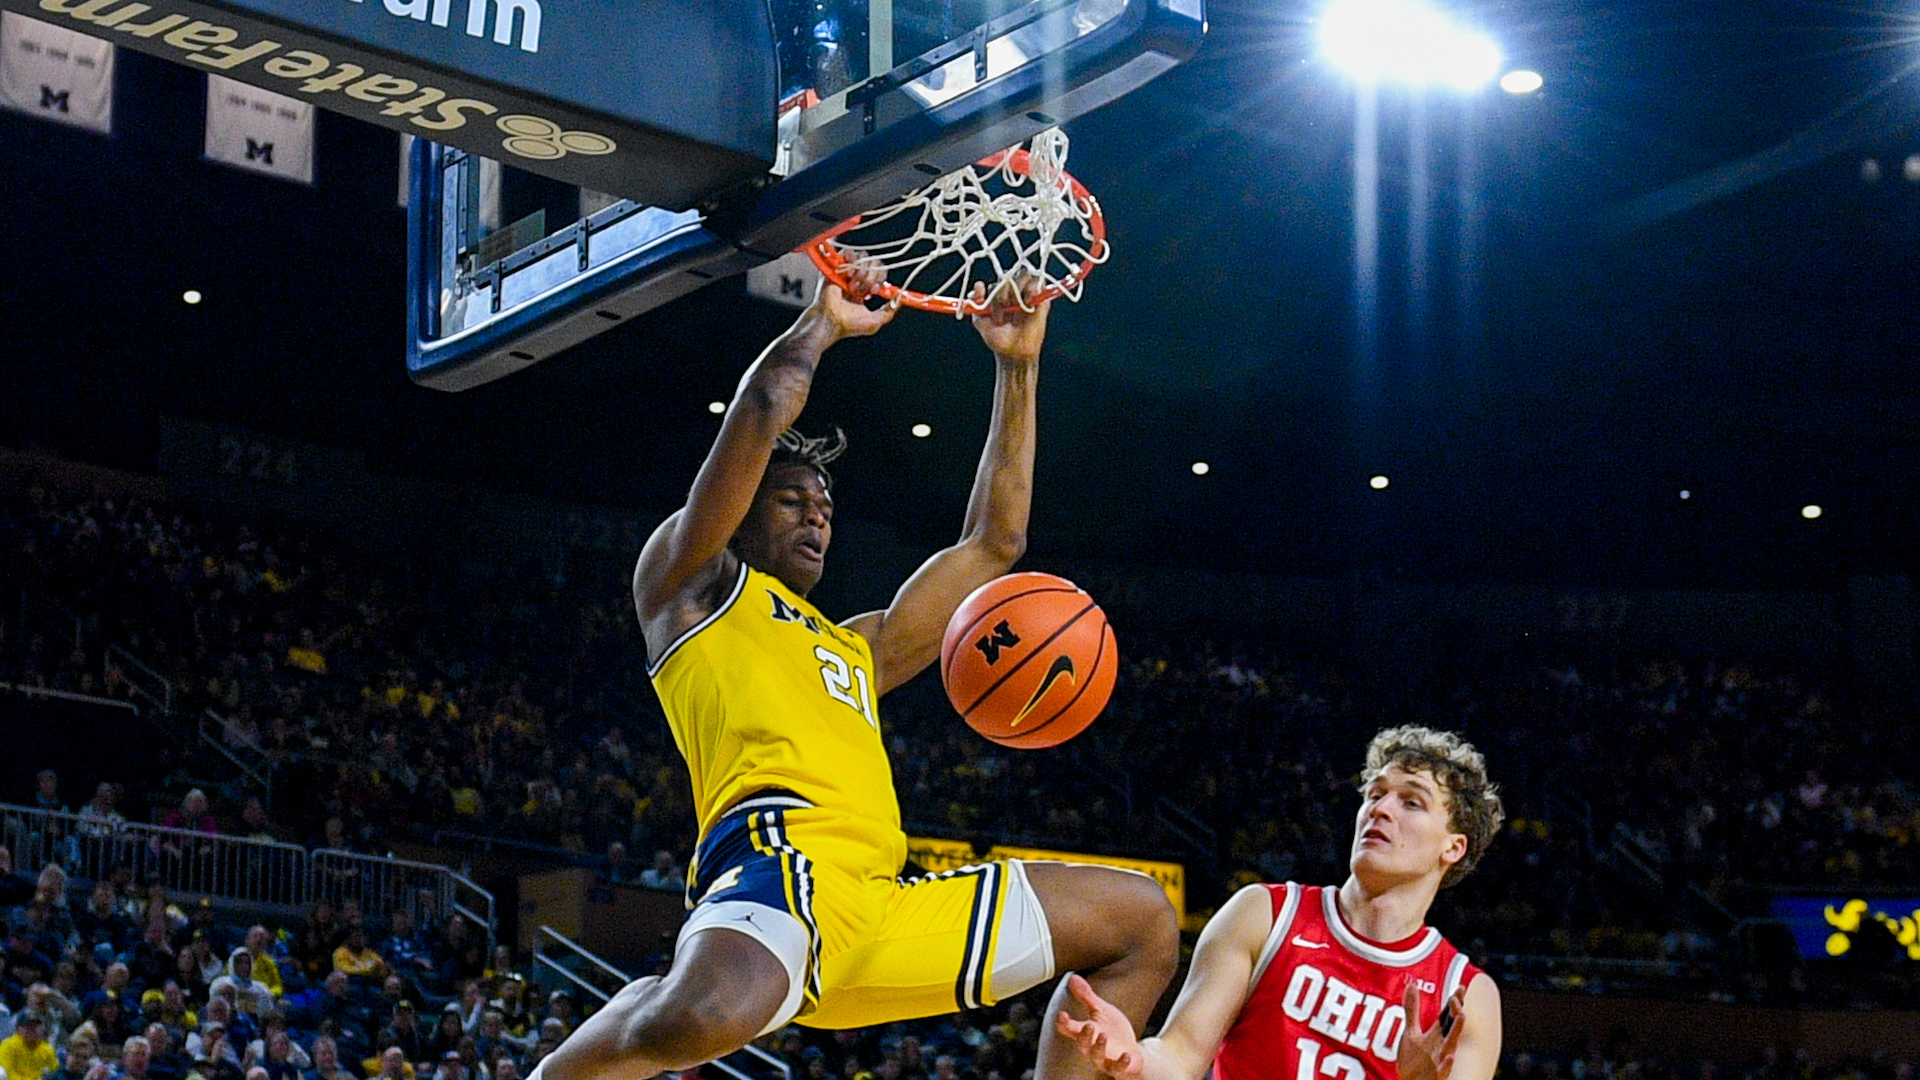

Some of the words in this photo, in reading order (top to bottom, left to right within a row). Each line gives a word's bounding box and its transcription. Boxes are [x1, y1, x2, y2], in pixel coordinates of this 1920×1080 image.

[40, 83, 70, 113] M
[244, 136, 274, 166] M
[780, 274, 803, 300] M
[975, 618, 1021, 666] M
[812, 644, 877, 732] 21
[1282, 964, 1406, 1062] OHIO
